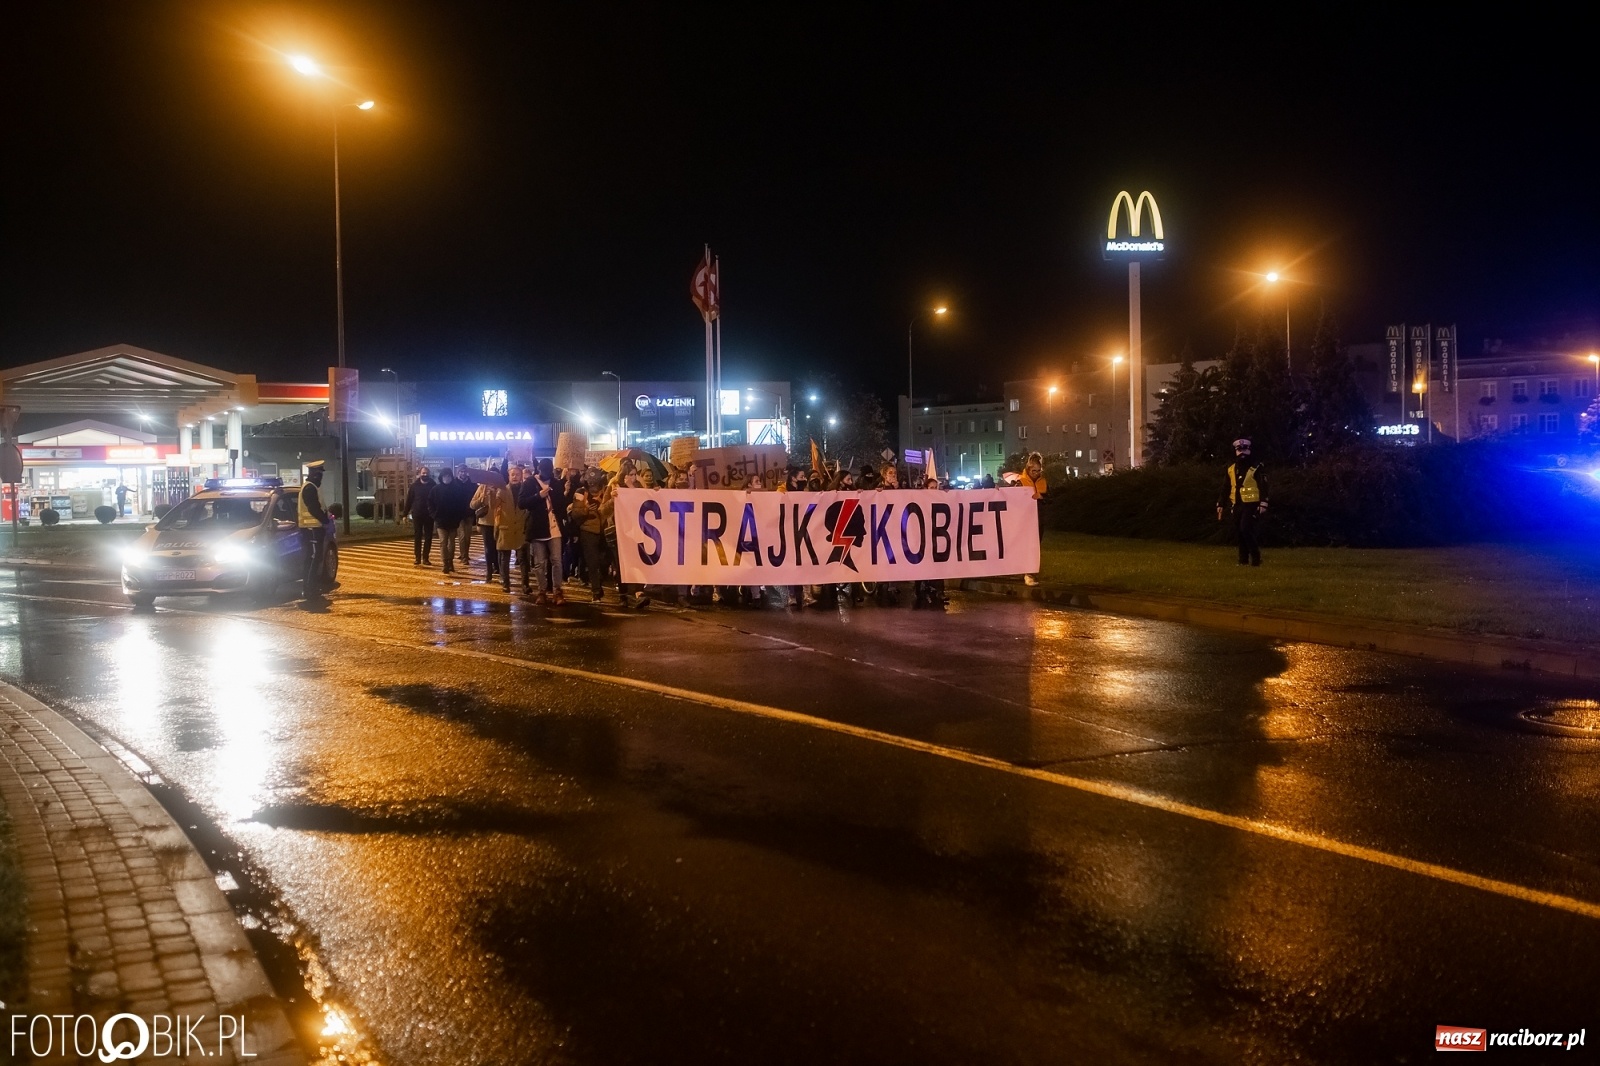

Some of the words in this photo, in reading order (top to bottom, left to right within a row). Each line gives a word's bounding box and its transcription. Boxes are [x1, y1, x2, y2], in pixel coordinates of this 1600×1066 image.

[1106, 241, 1164, 251] McDonald's
[656, 398, 695, 407] ŁAZIENKI
[1378, 424, 1420, 435] nald's
[429, 431, 532, 441] RESTAURACJA
[694, 458, 720, 489] To
[638, 499, 819, 567] STRAJK
[870, 501, 1007, 565] KOBIET
[155, 541, 207, 549] POLICJA
